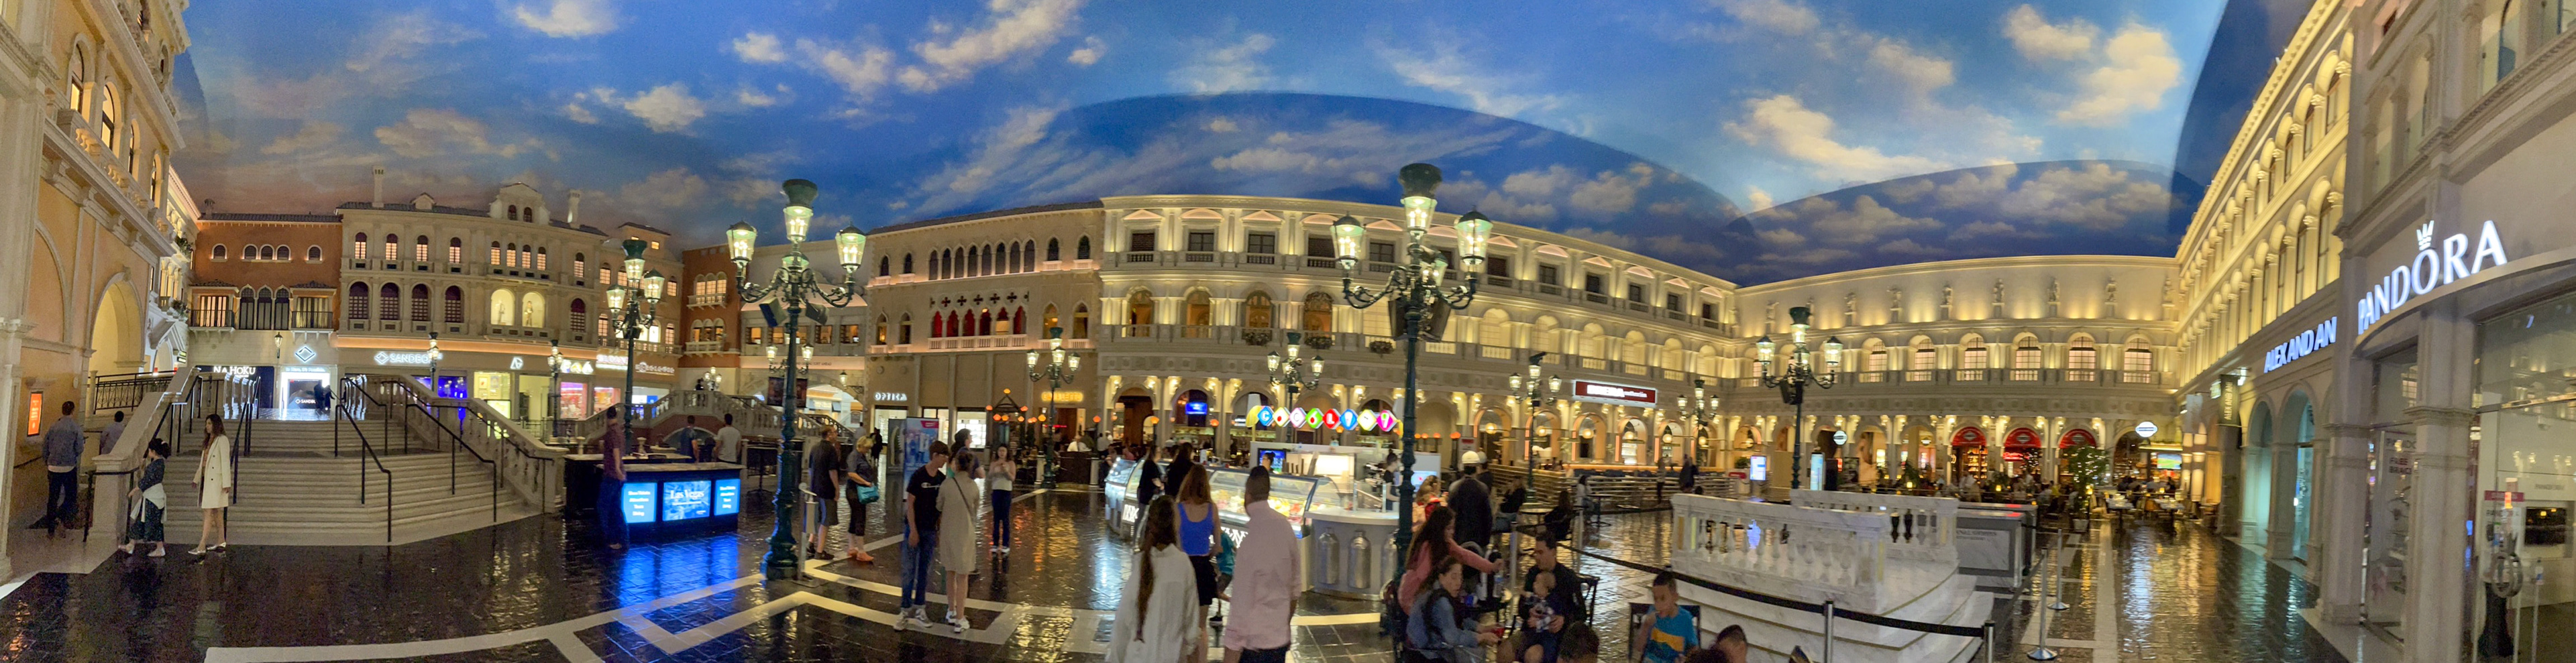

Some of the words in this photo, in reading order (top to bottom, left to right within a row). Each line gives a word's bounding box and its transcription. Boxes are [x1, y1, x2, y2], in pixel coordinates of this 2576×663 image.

[2358, 220, 2508, 335] PANDORA
[2263, 342, 2288, 373] ALEX
[2286, 329, 2315, 363] AND
[389, 353, 431, 364] SANDBO
[229, 366, 256, 375] HOKU
[2225, 381, 2233, 392] ANI
[2224, 393, 2233, 406] AND
[2224, 406, 2233, 420] ALEX
[671, 490, 684, 499] Las
[684, 489, 704, 500] Vegas
